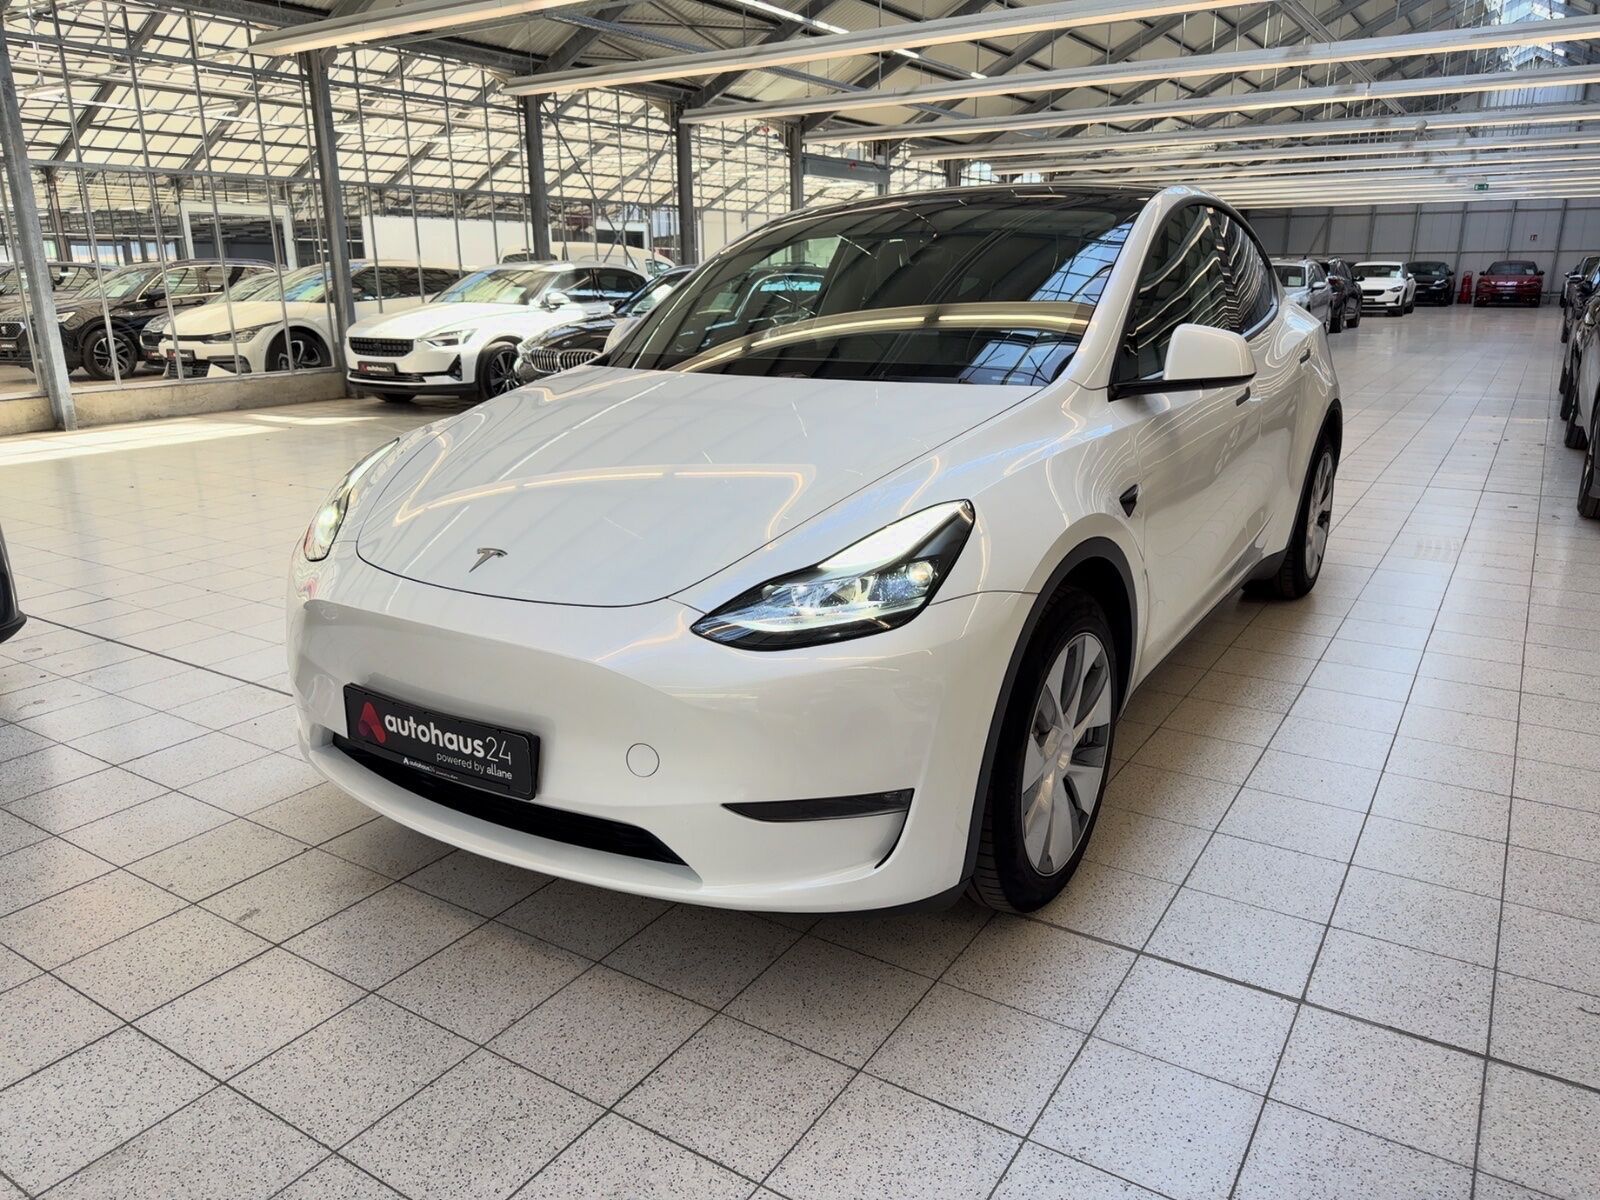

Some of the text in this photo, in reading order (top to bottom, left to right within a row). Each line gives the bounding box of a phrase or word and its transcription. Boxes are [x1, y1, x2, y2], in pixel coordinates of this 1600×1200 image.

[384, 714, 512, 766] autohaus24
[436, 752, 473, 770] powered
[474, 761, 485, 776] by
[486, 763, 513, 780] allane
